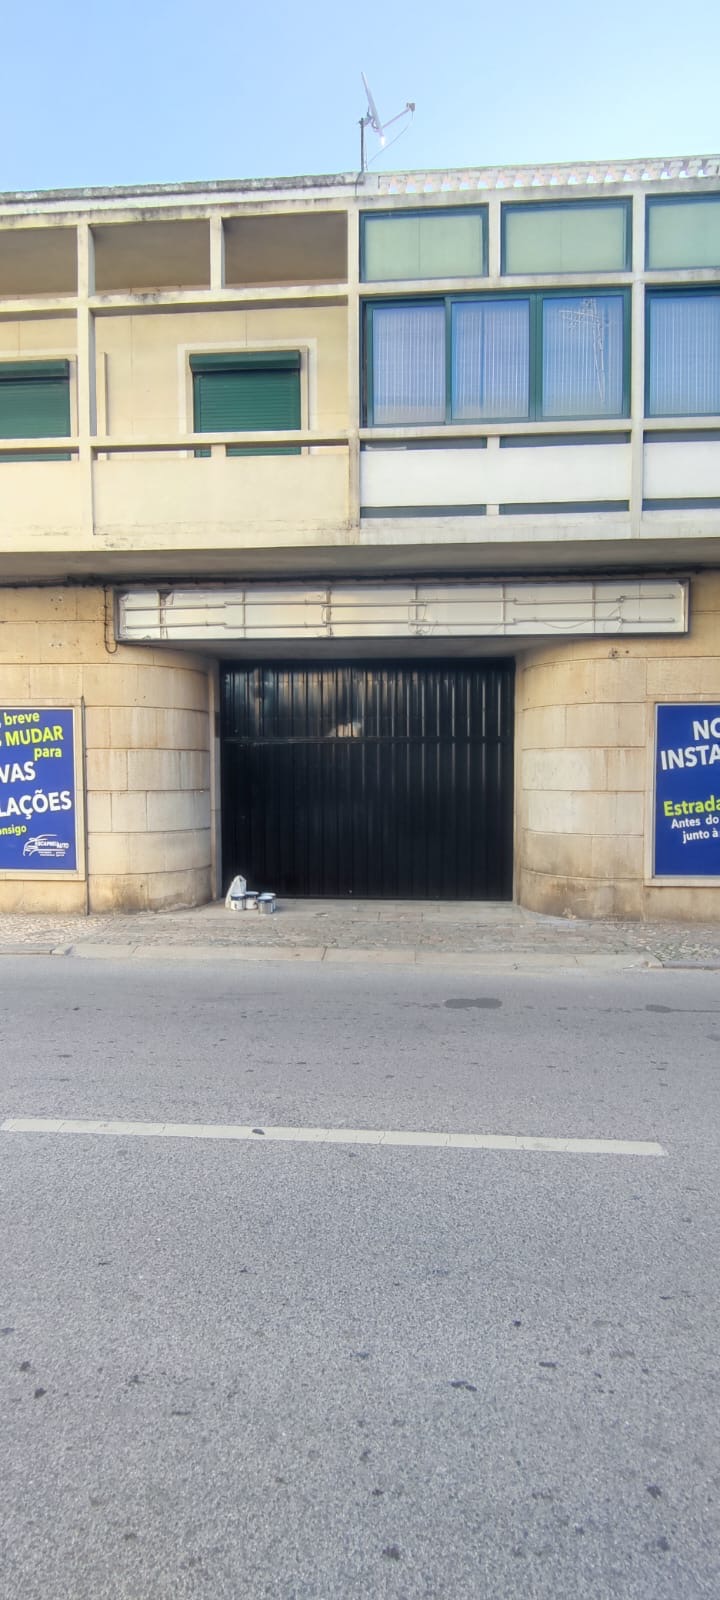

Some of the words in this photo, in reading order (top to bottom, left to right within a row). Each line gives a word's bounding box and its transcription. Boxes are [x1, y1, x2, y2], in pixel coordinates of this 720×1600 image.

[4, 712, 40, 726] breve
[5, 725, 64, 746] MUDAR
[34, 747, 62, 761] para
[660, 744, 720, 771] INSTA
[0, 761, 36, 783] VAS
[671, 818, 701, 830] Antes
[705, 814, 719, 825] do
[682, 830, 710, 845] junto
